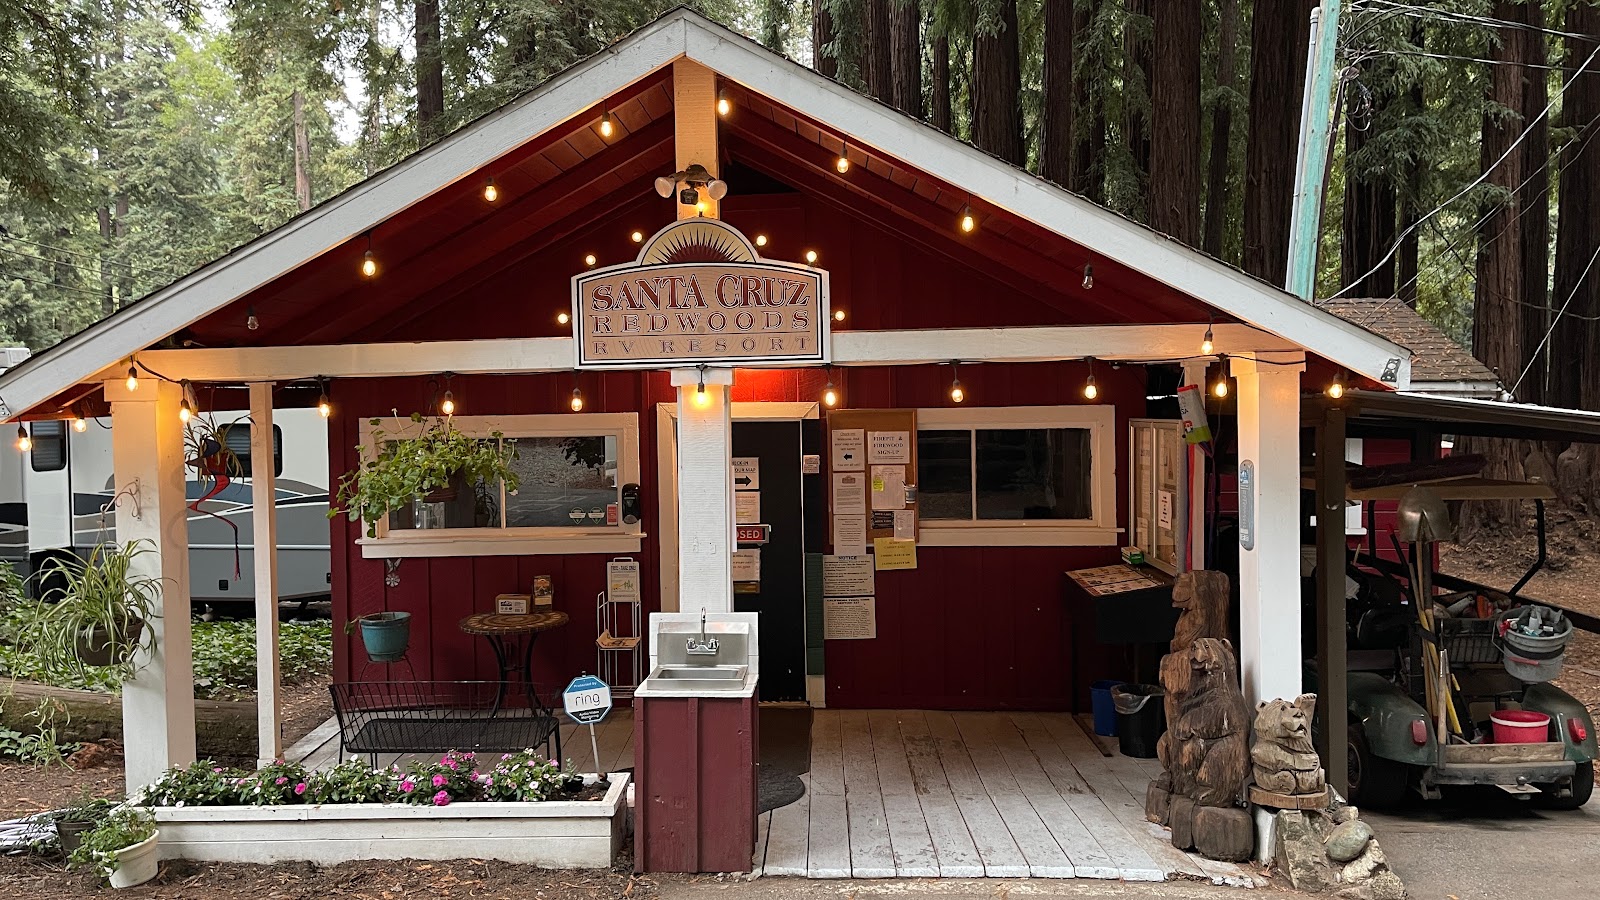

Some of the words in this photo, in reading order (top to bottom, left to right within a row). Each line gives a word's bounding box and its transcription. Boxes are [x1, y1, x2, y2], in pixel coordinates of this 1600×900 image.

[591, 274, 708, 311] SANTA
[714, 274, 811, 309] CRUZ
[589, 311, 810, 334] REDWOODS
[592, 340, 635, 355] RV
[659, 336, 810, 354] RESORT
[575, 693, 600, 706] ring
